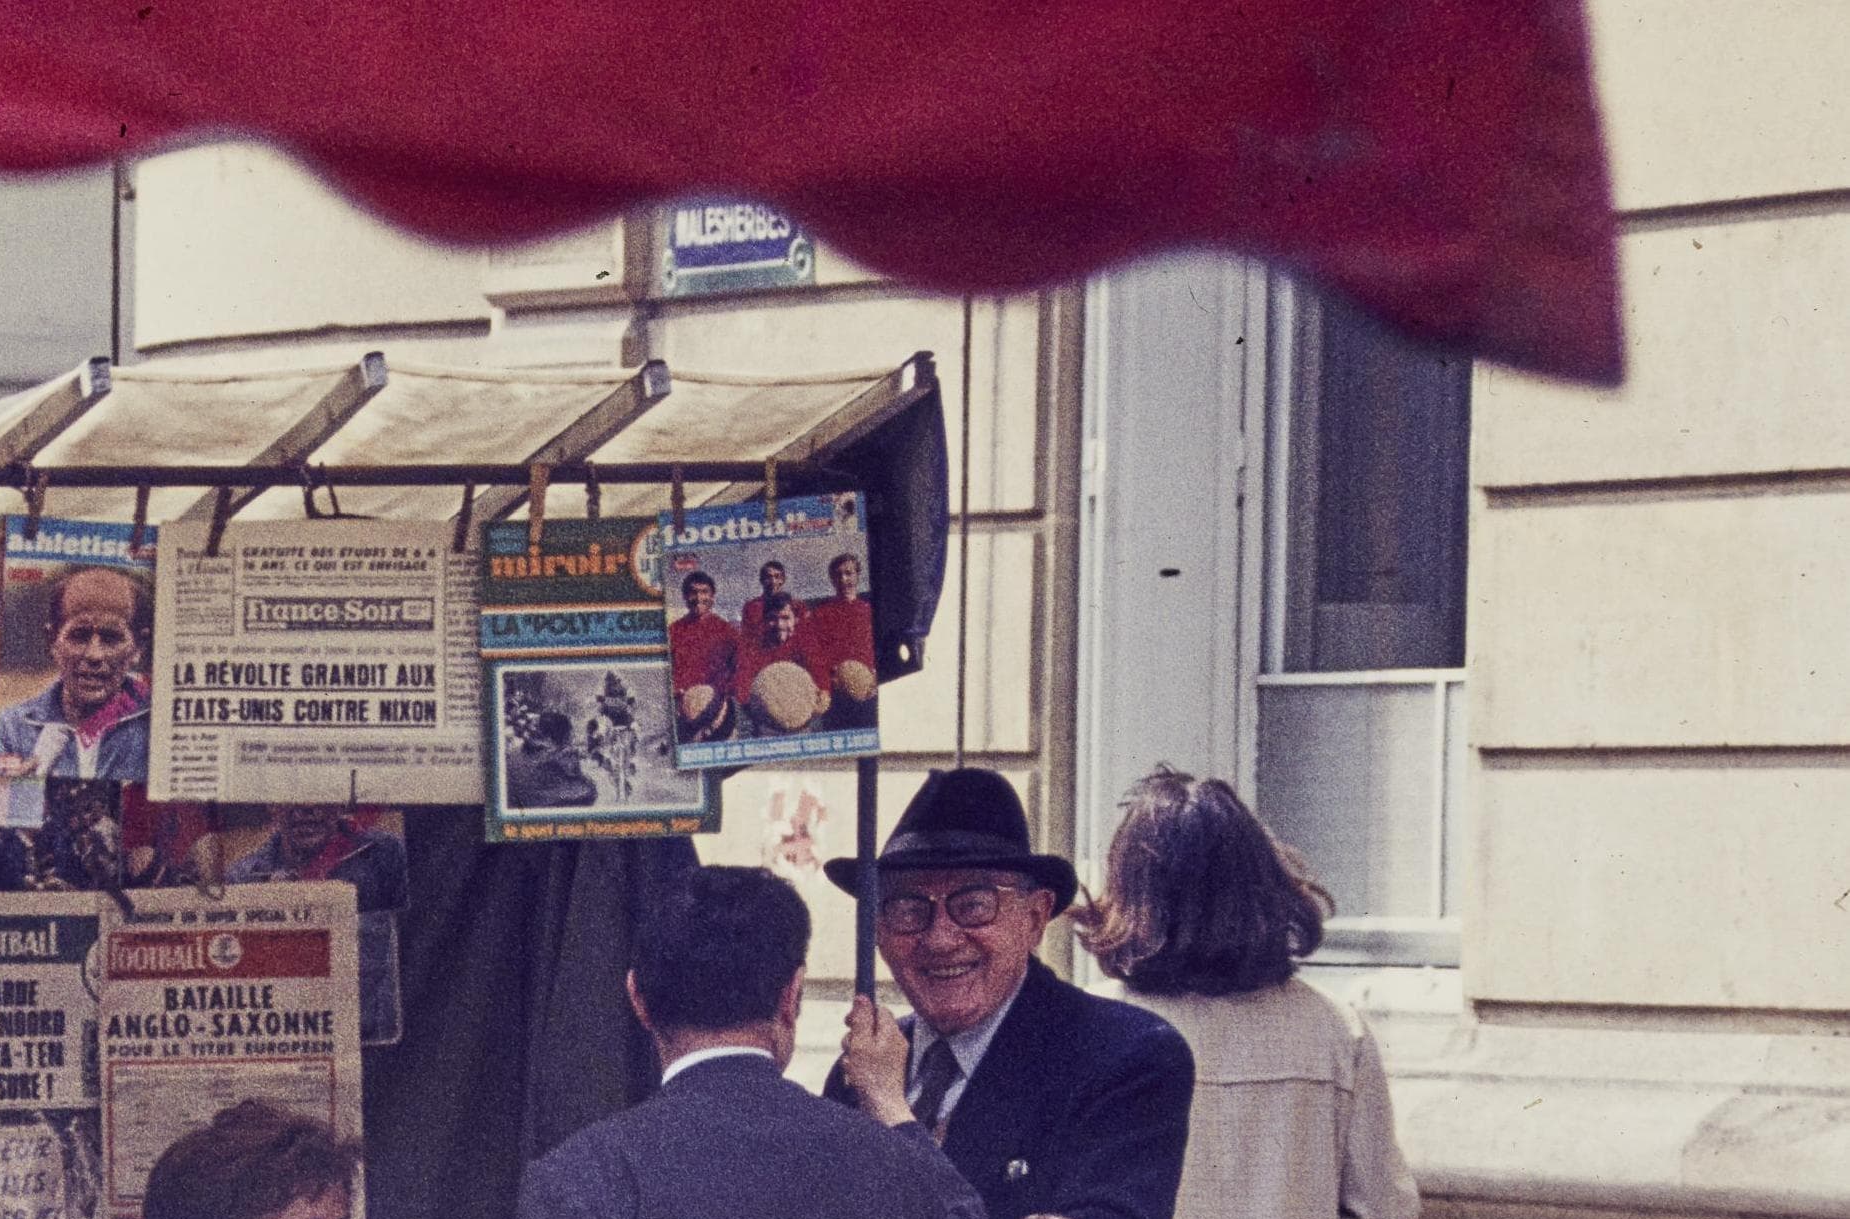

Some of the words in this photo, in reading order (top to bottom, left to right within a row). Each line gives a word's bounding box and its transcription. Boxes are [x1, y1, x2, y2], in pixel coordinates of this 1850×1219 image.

[295, 560, 310, 571] CE
[313, 560, 338, 572] QUI
[343, 560, 363, 571] EST
[491, 542, 628, 578] miroir
[173, 662, 196, 686] LA
[205, 659, 292, 687] RÉVOLTE
[301, 663, 388, 687] GRANDIT
[396, 663, 437, 687] AUX
[294, 699, 369, 722] CONTRE
[379, 699, 437, 722] NIXON
[164, 984, 274, 1011] BATAILLE
[107, 1043, 153, 1057] POUR
[161, 1043, 180, 1057] LE
[191, 1041, 236, 1056] TITRE
